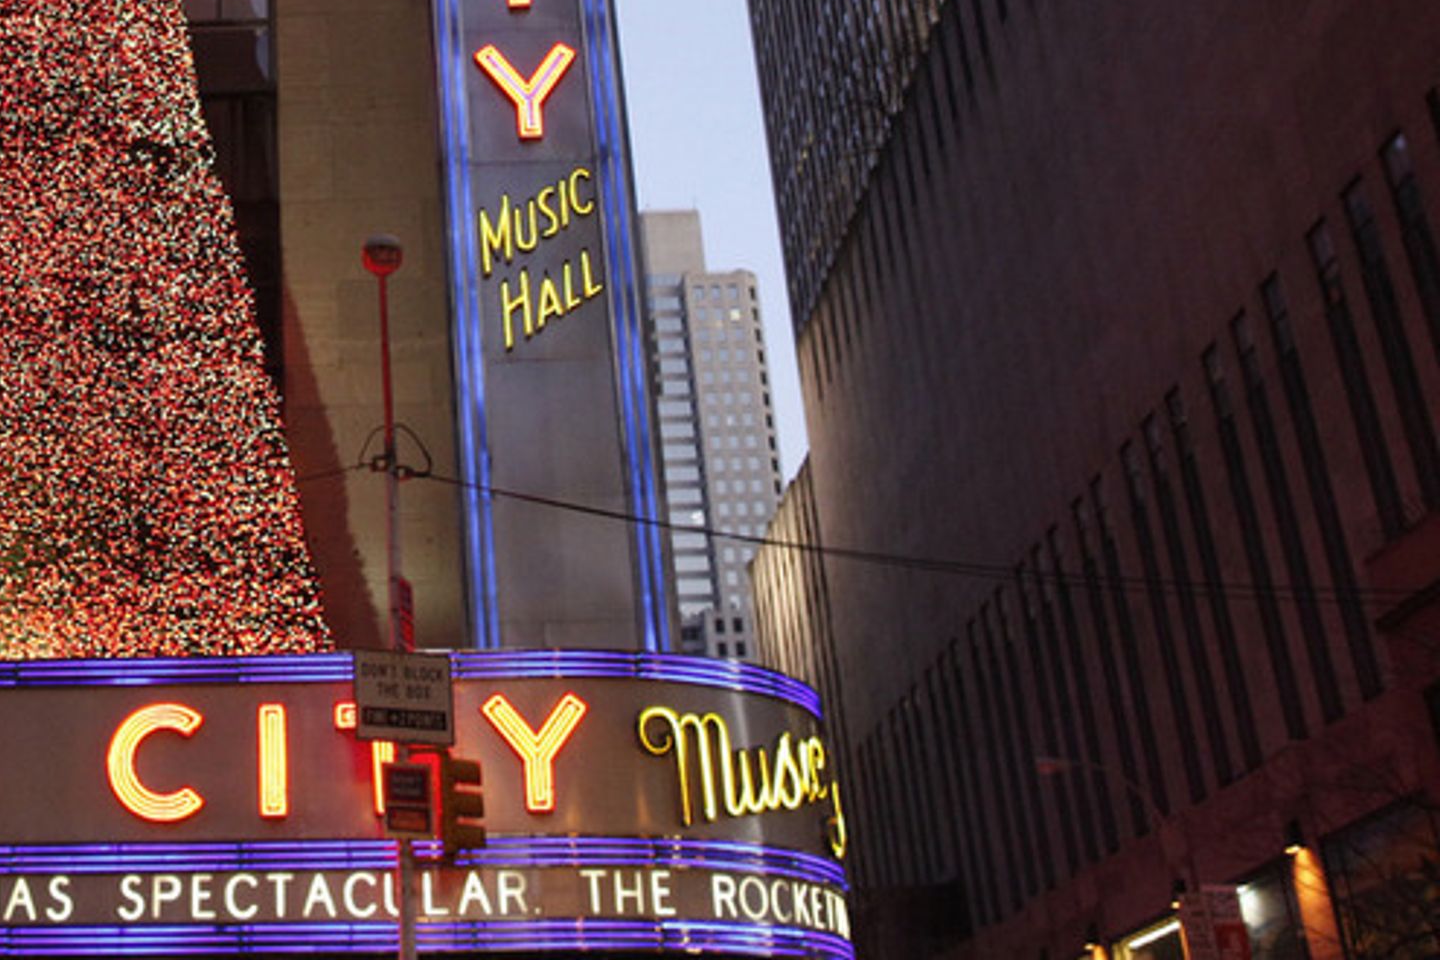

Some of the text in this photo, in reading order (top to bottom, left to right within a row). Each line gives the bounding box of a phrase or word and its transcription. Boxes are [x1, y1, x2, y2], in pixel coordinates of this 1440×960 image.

[478, 167, 595, 274] MUSIC
[500, 251, 604, 349] HALL
[377, 681, 432, 700] THE BOX
[403, 665, 443, 682] BLOCK
[578, 868, 678, 916] THE
